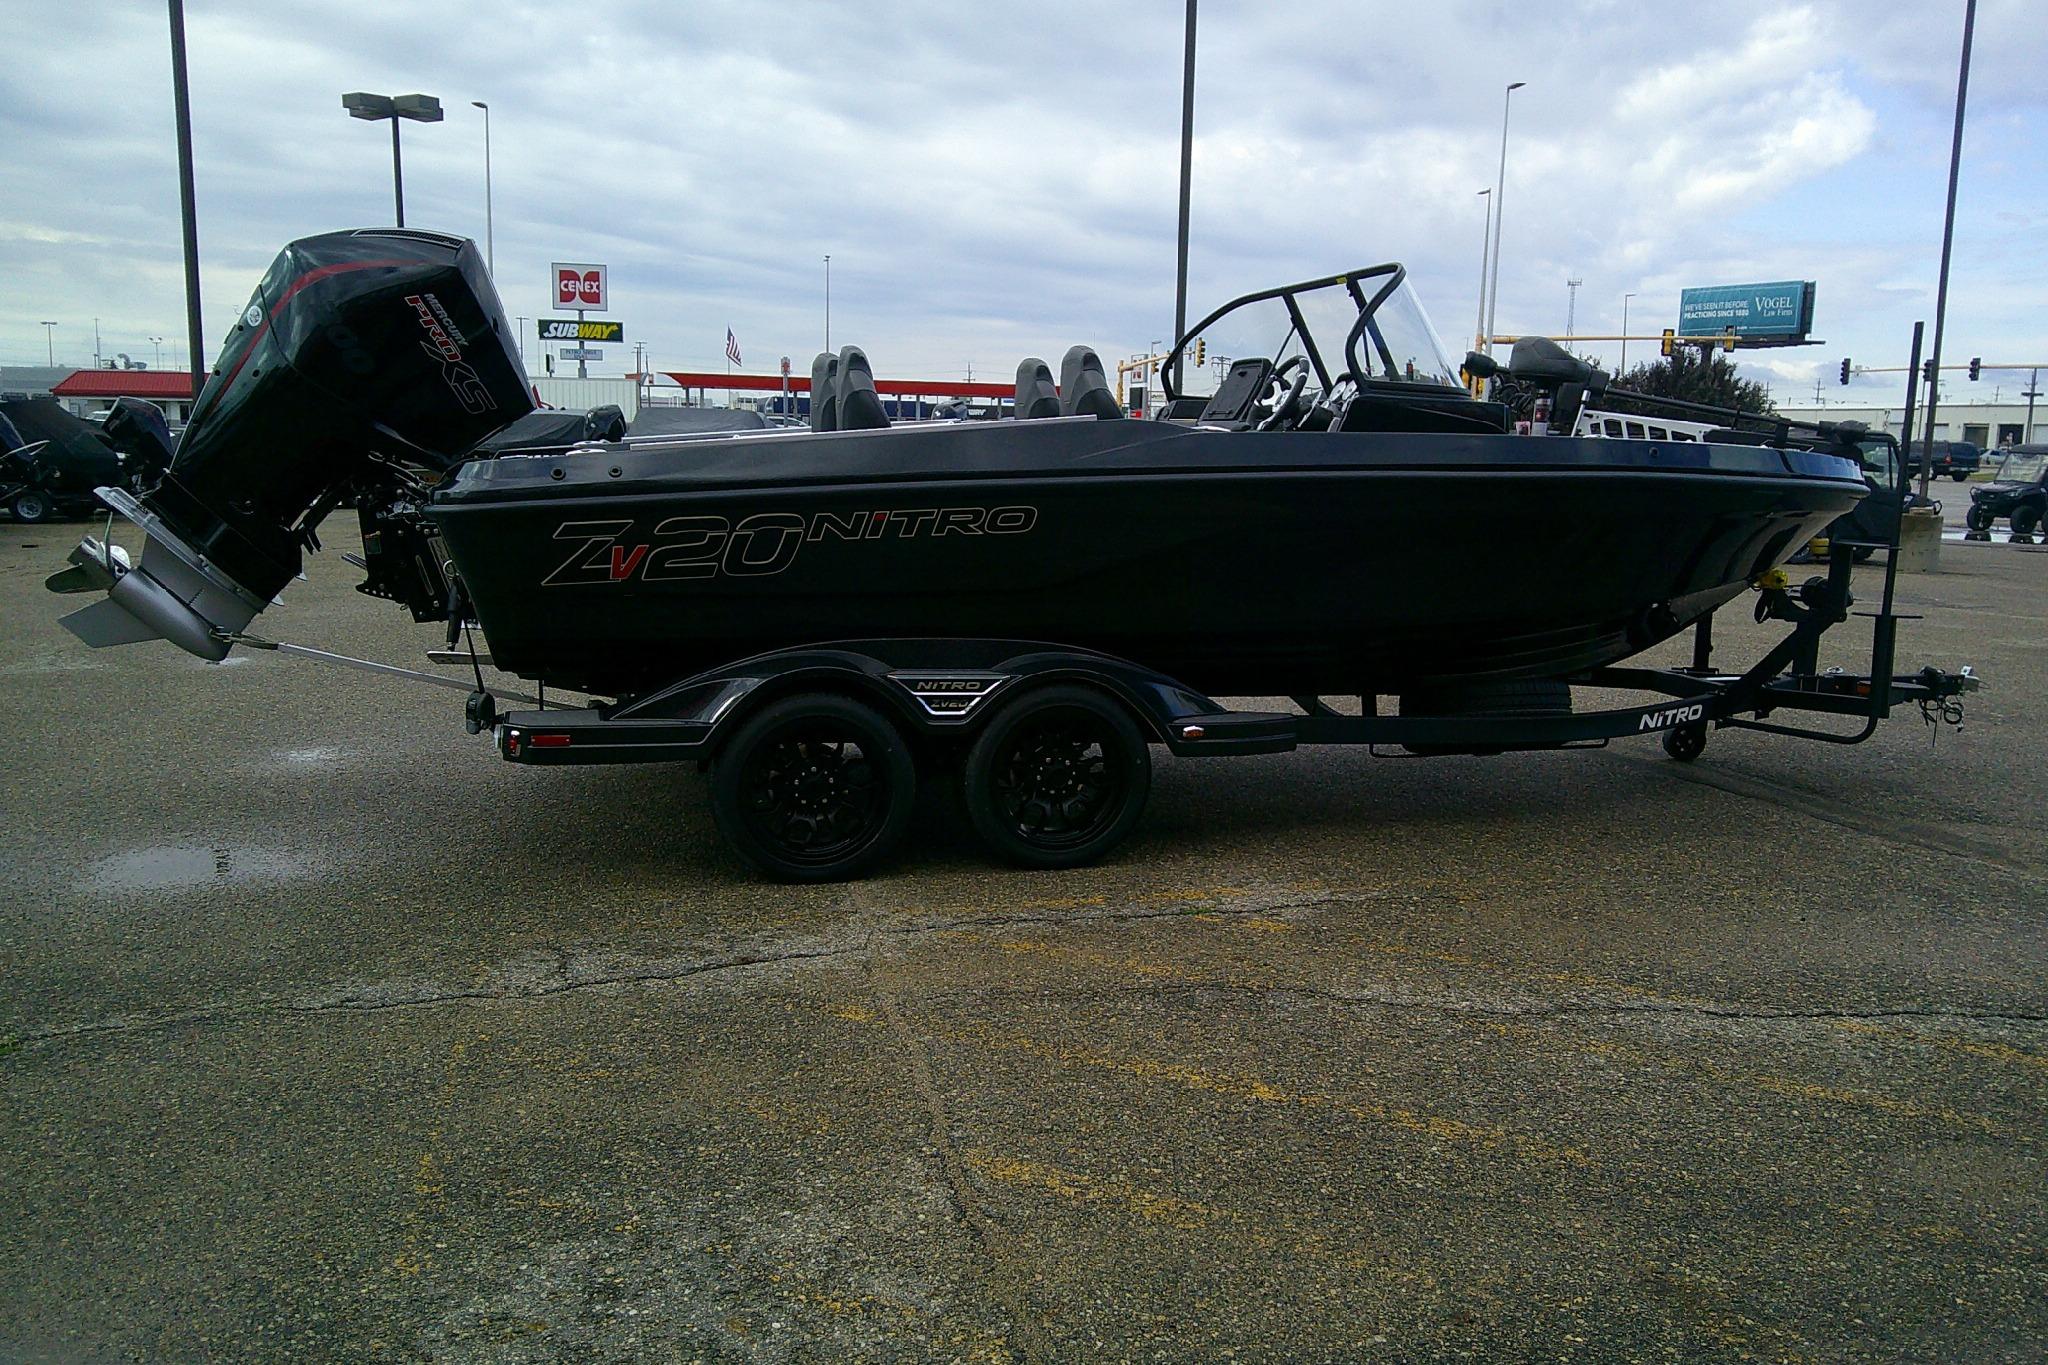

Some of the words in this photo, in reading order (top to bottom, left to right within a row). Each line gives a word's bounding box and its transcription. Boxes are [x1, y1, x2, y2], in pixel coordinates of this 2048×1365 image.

[560, 280, 600, 293] CENEX
[1724, 300, 1749, 309] BEFORE
[1755, 296, 1793, 311] VOGEL
[423, 293, 470, 346] MERCURY
[1683, 310, 1716, 319] PRACTICING
[1717, 309, 1734, 317] SINCE
[1763, 309, 1775, 317] Law
[1777, 308, 1793, 316] Firm
[404, 295, 462, 362] PRO
[543, 322, 618, 339] SUBWAY
[419, 337, 498, 415] XS
[806, 505, 1039, 542] NITRO
[916, 681, 981, 690] NITRO
[1638, 703, 1703, 731] NITRO
